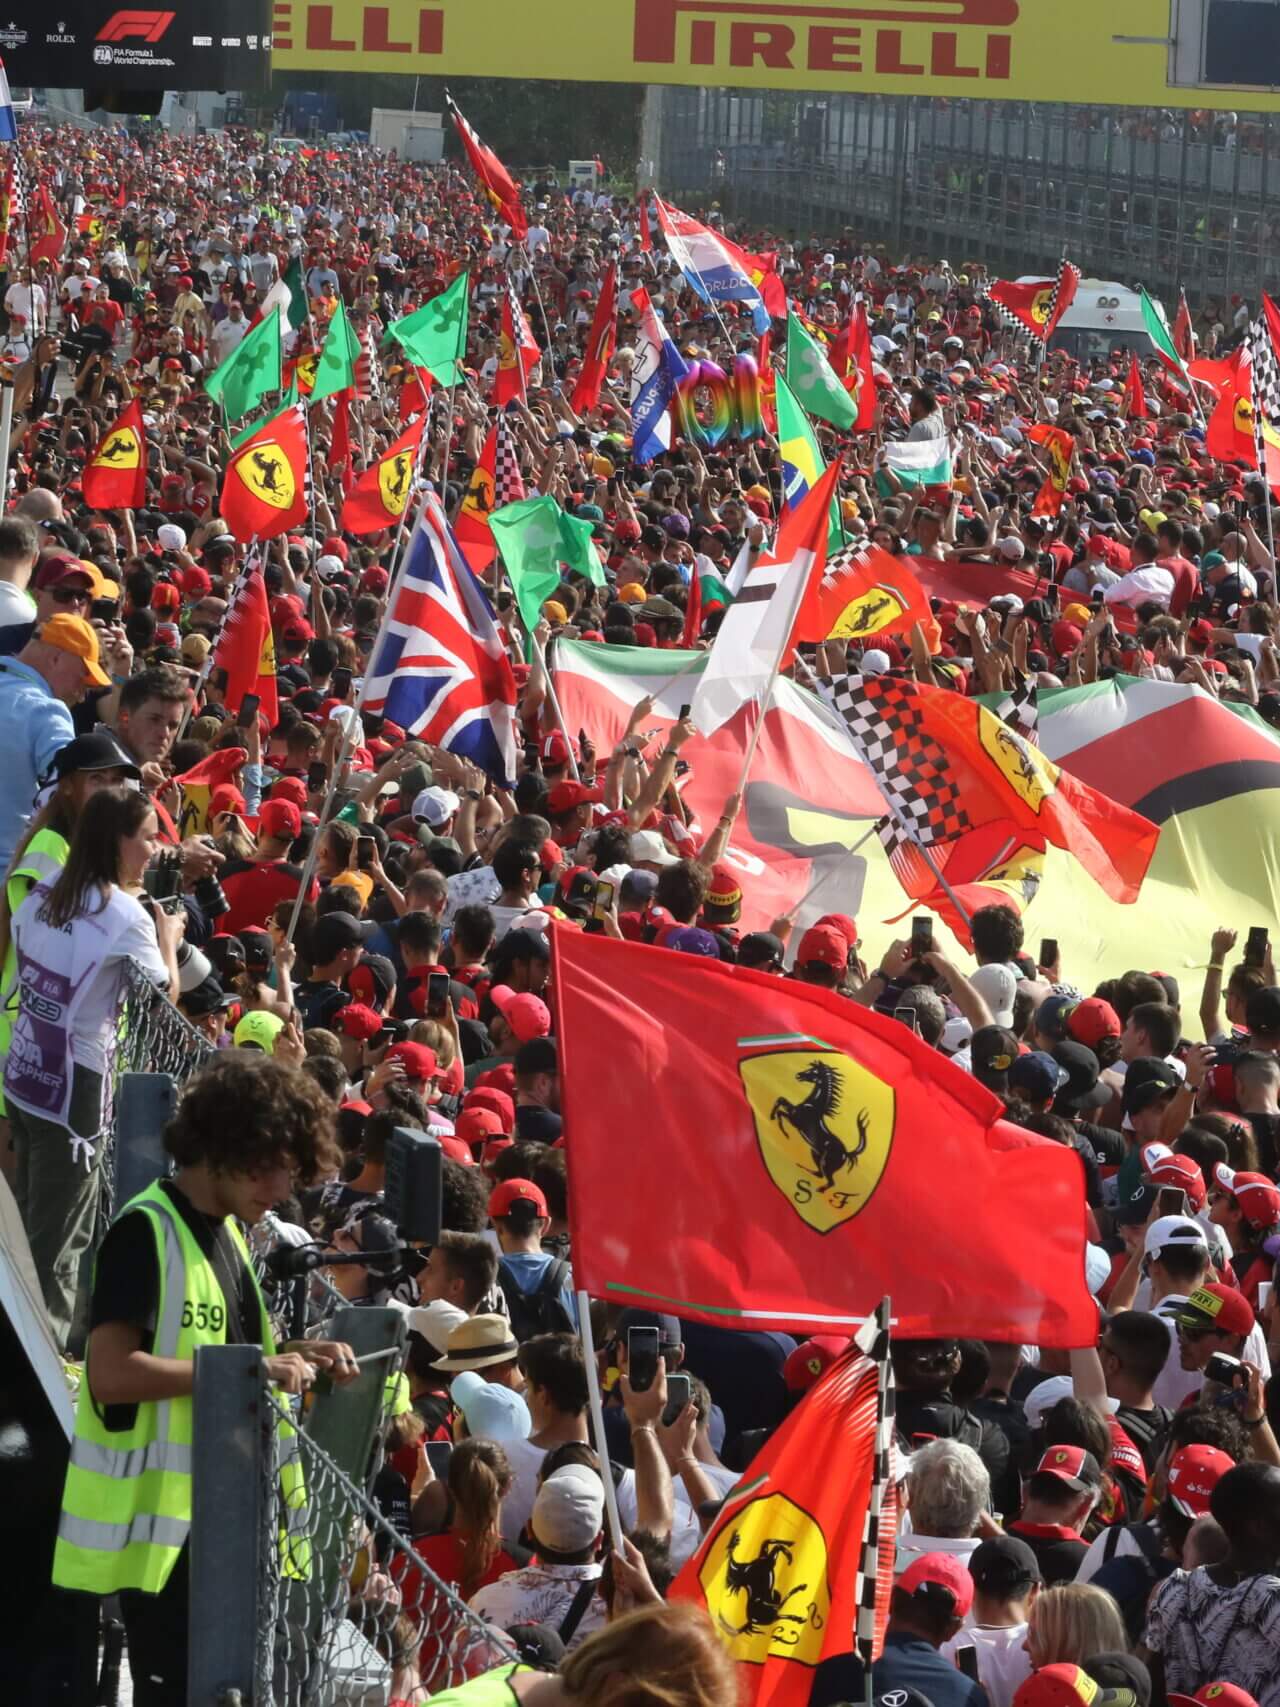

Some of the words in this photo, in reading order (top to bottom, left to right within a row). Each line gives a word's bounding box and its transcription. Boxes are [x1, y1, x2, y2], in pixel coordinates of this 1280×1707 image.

[46, 34, 76, 43] ROLEX
[633, 0, 1019, 79] PIRELLI
[95, 48, 113, 62] FIA
[125, 49, 149, 57] Formula
[113, 57, 132, 65] World
[132, 57, 171, 66] Championship
[180, 1301, 224, 1333] 659
